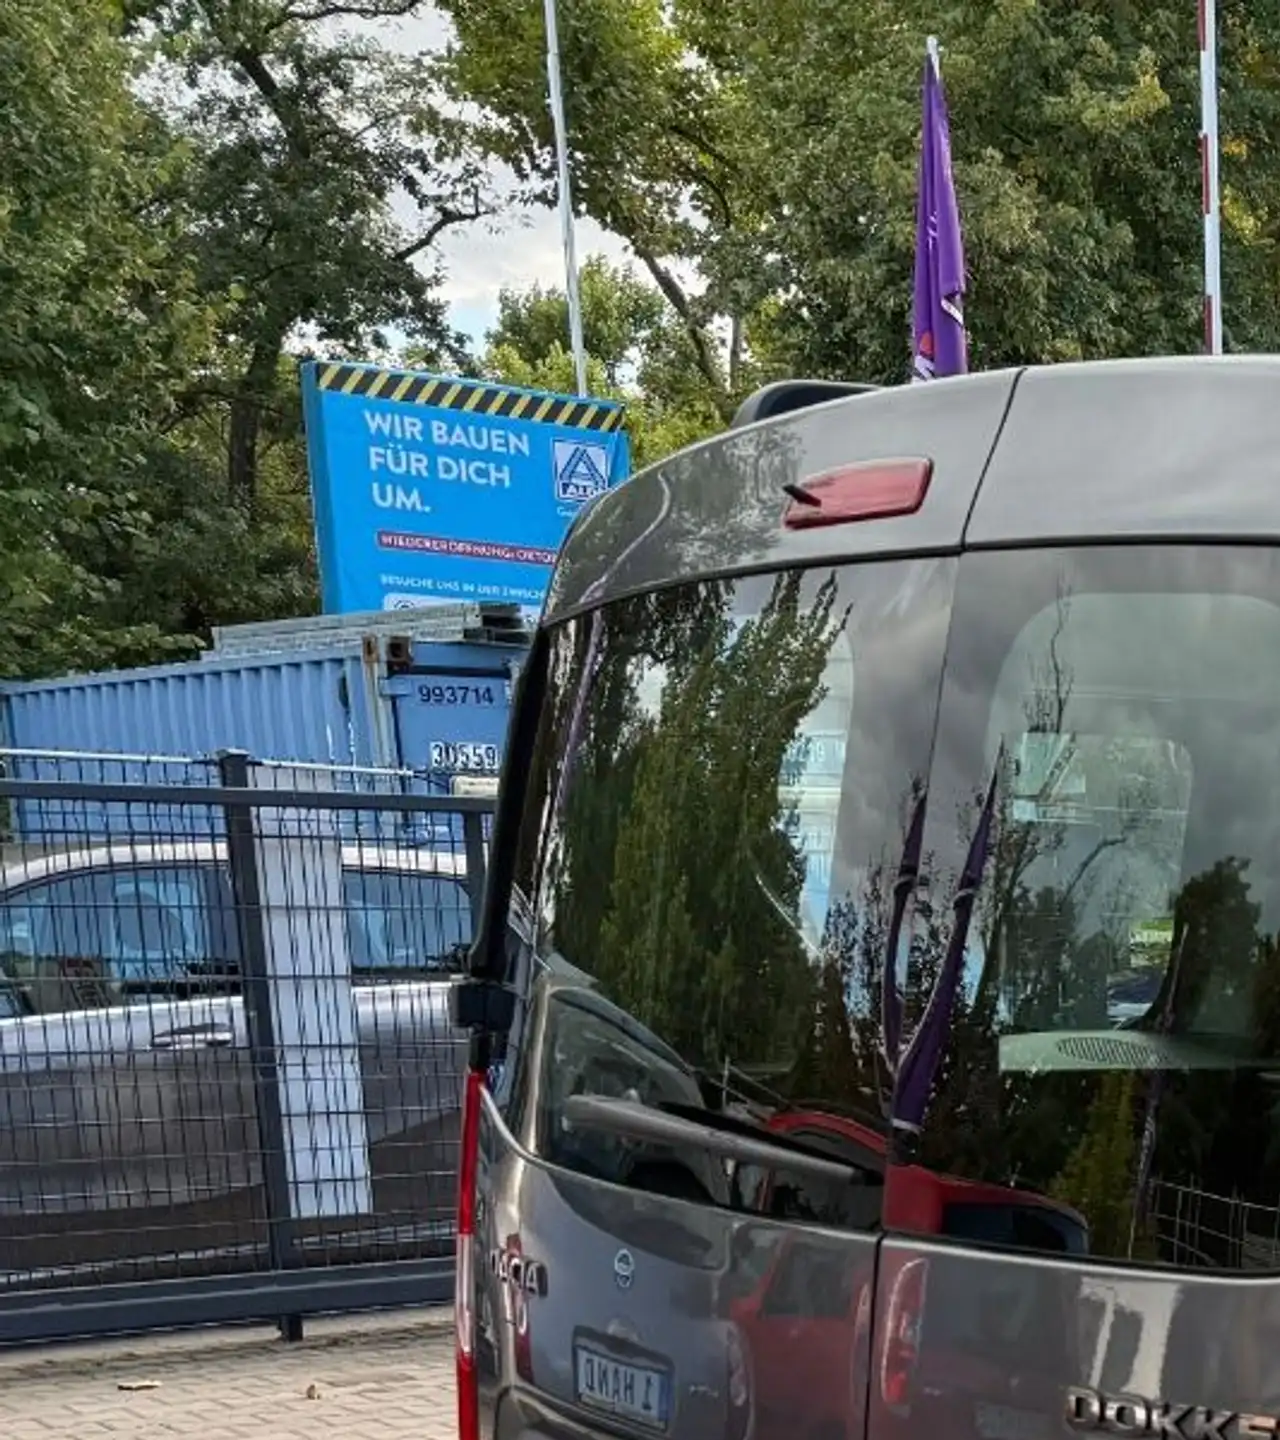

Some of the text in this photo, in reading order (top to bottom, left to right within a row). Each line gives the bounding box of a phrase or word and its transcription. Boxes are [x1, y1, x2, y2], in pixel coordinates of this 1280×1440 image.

[365, 410, 530, 456] WIR BAUEN
[369, 443, 511, 488] FÜR DICH
[372, 482, 431, 513] UM.
[417, 683, 495, 705] 993714
